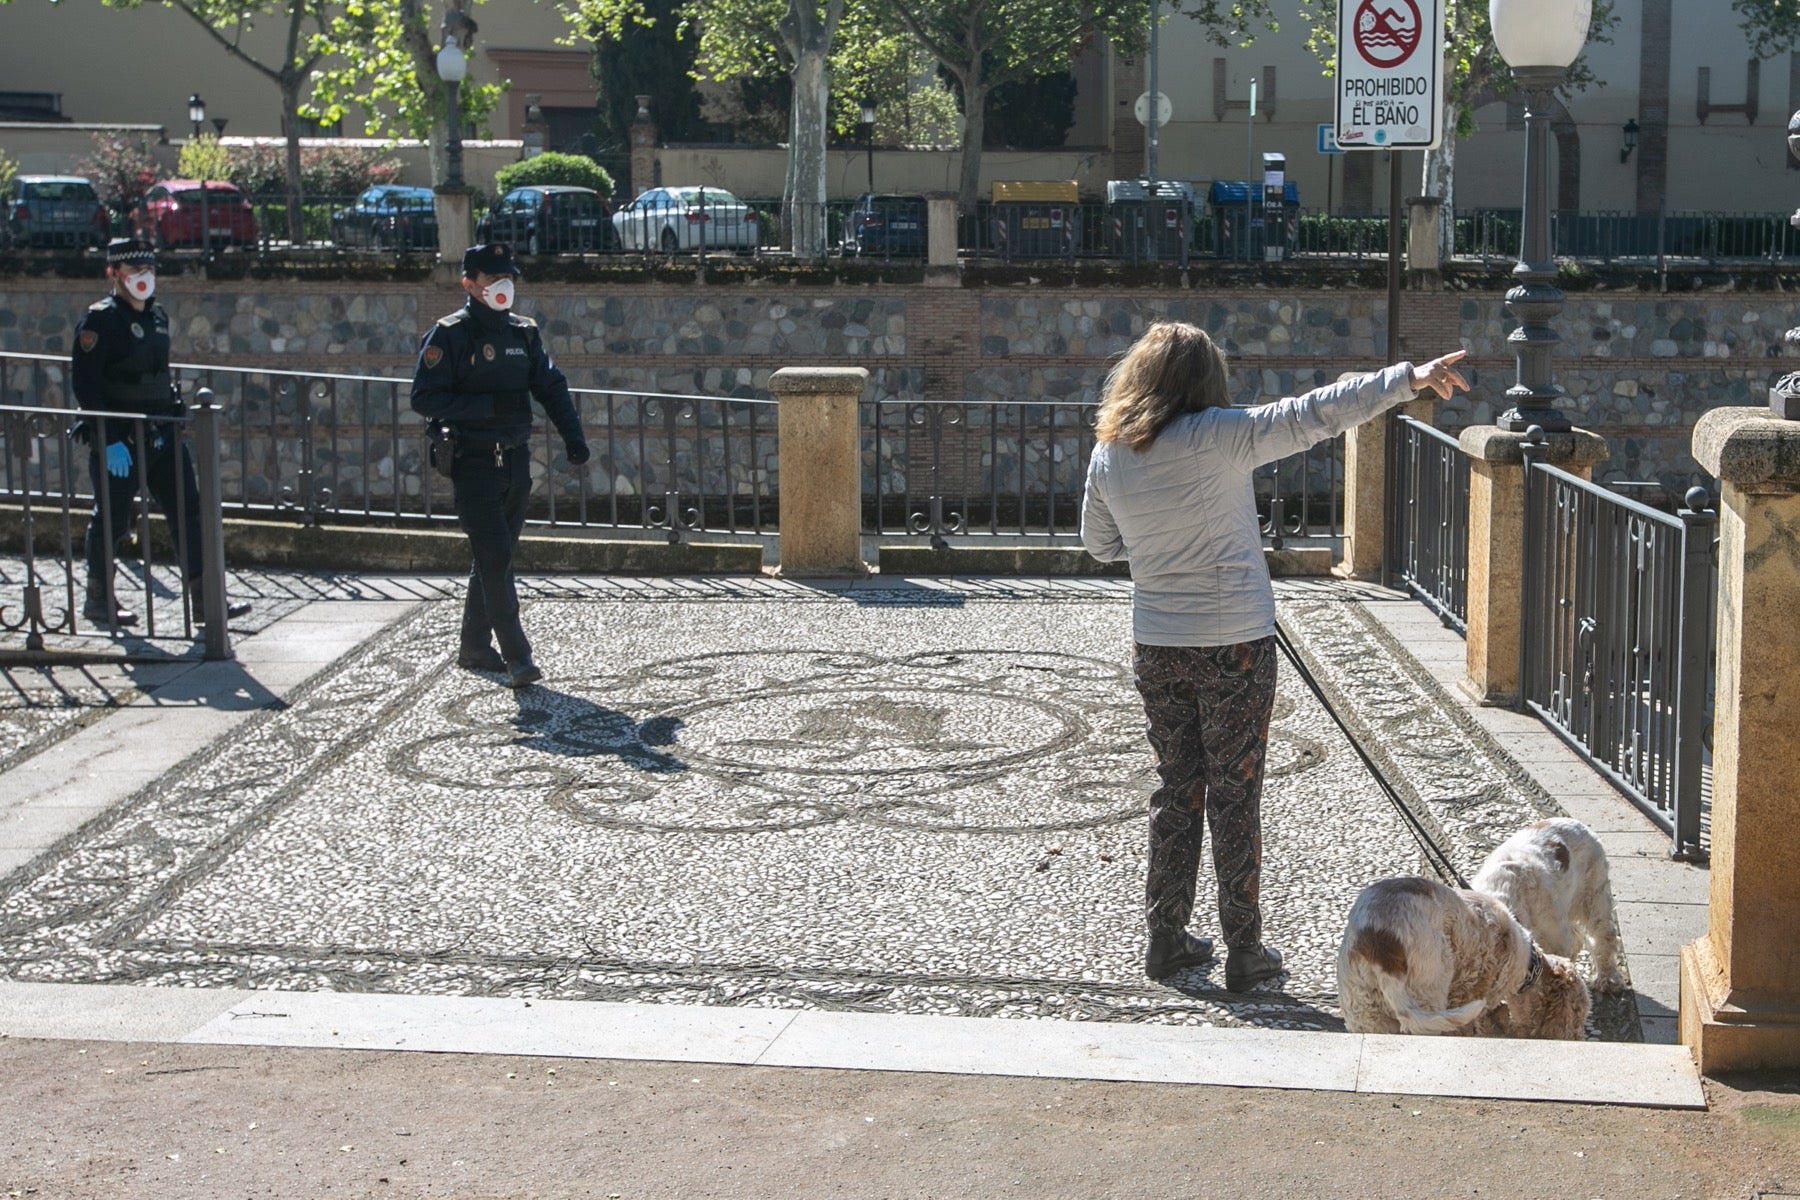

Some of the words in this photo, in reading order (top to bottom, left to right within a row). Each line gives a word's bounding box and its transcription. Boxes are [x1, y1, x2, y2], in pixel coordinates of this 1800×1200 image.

[1345, 76, 1427, 97] PROHIBIDO
[1353, 107, 1371, 125] EL
[1375, 101, 1419, 125] BAÑO
